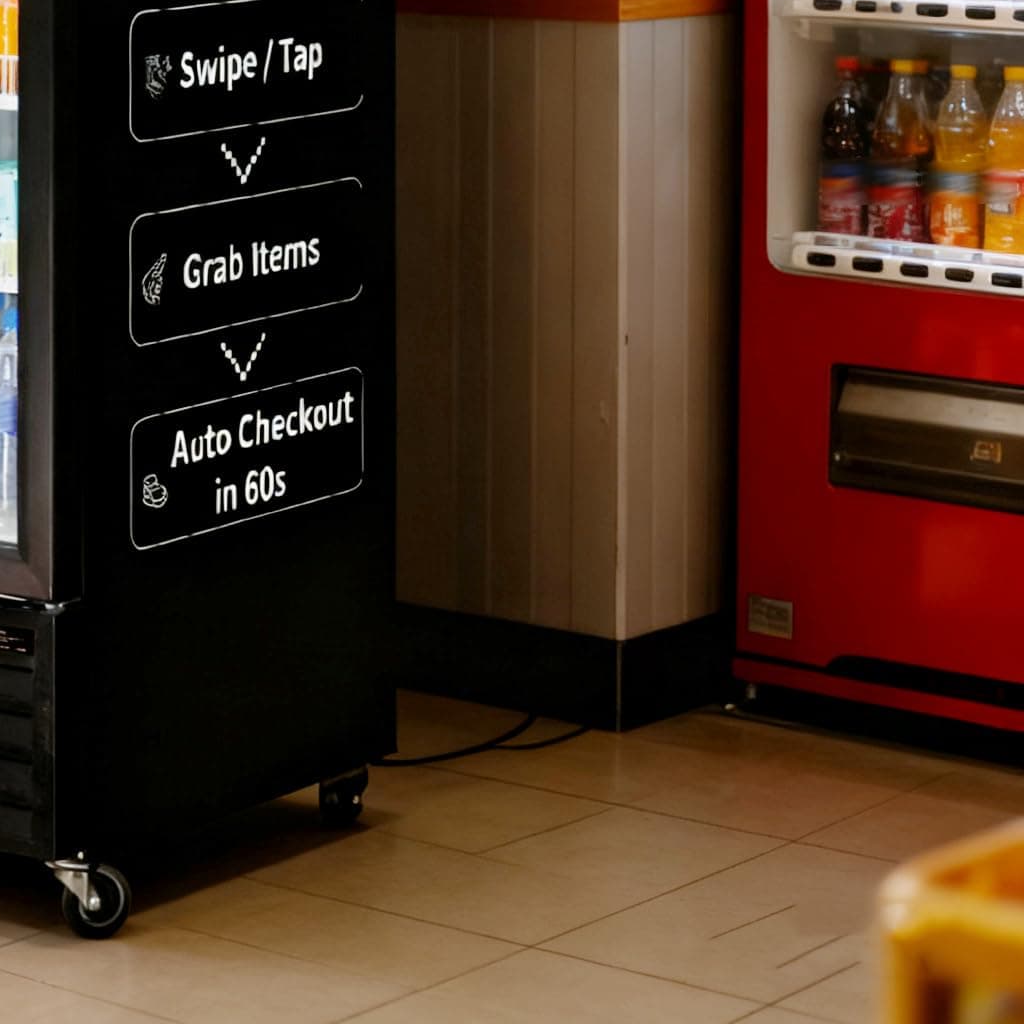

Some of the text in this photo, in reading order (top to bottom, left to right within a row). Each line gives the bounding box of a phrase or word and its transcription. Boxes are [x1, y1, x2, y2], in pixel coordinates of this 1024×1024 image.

[179, 37, 323, 92] Swipe / Tap
[183, 237, 321, 289] Grab Items
[170, 391, 355, 468] Auto Checkout
[215, 465, 287, 514] in 60s
